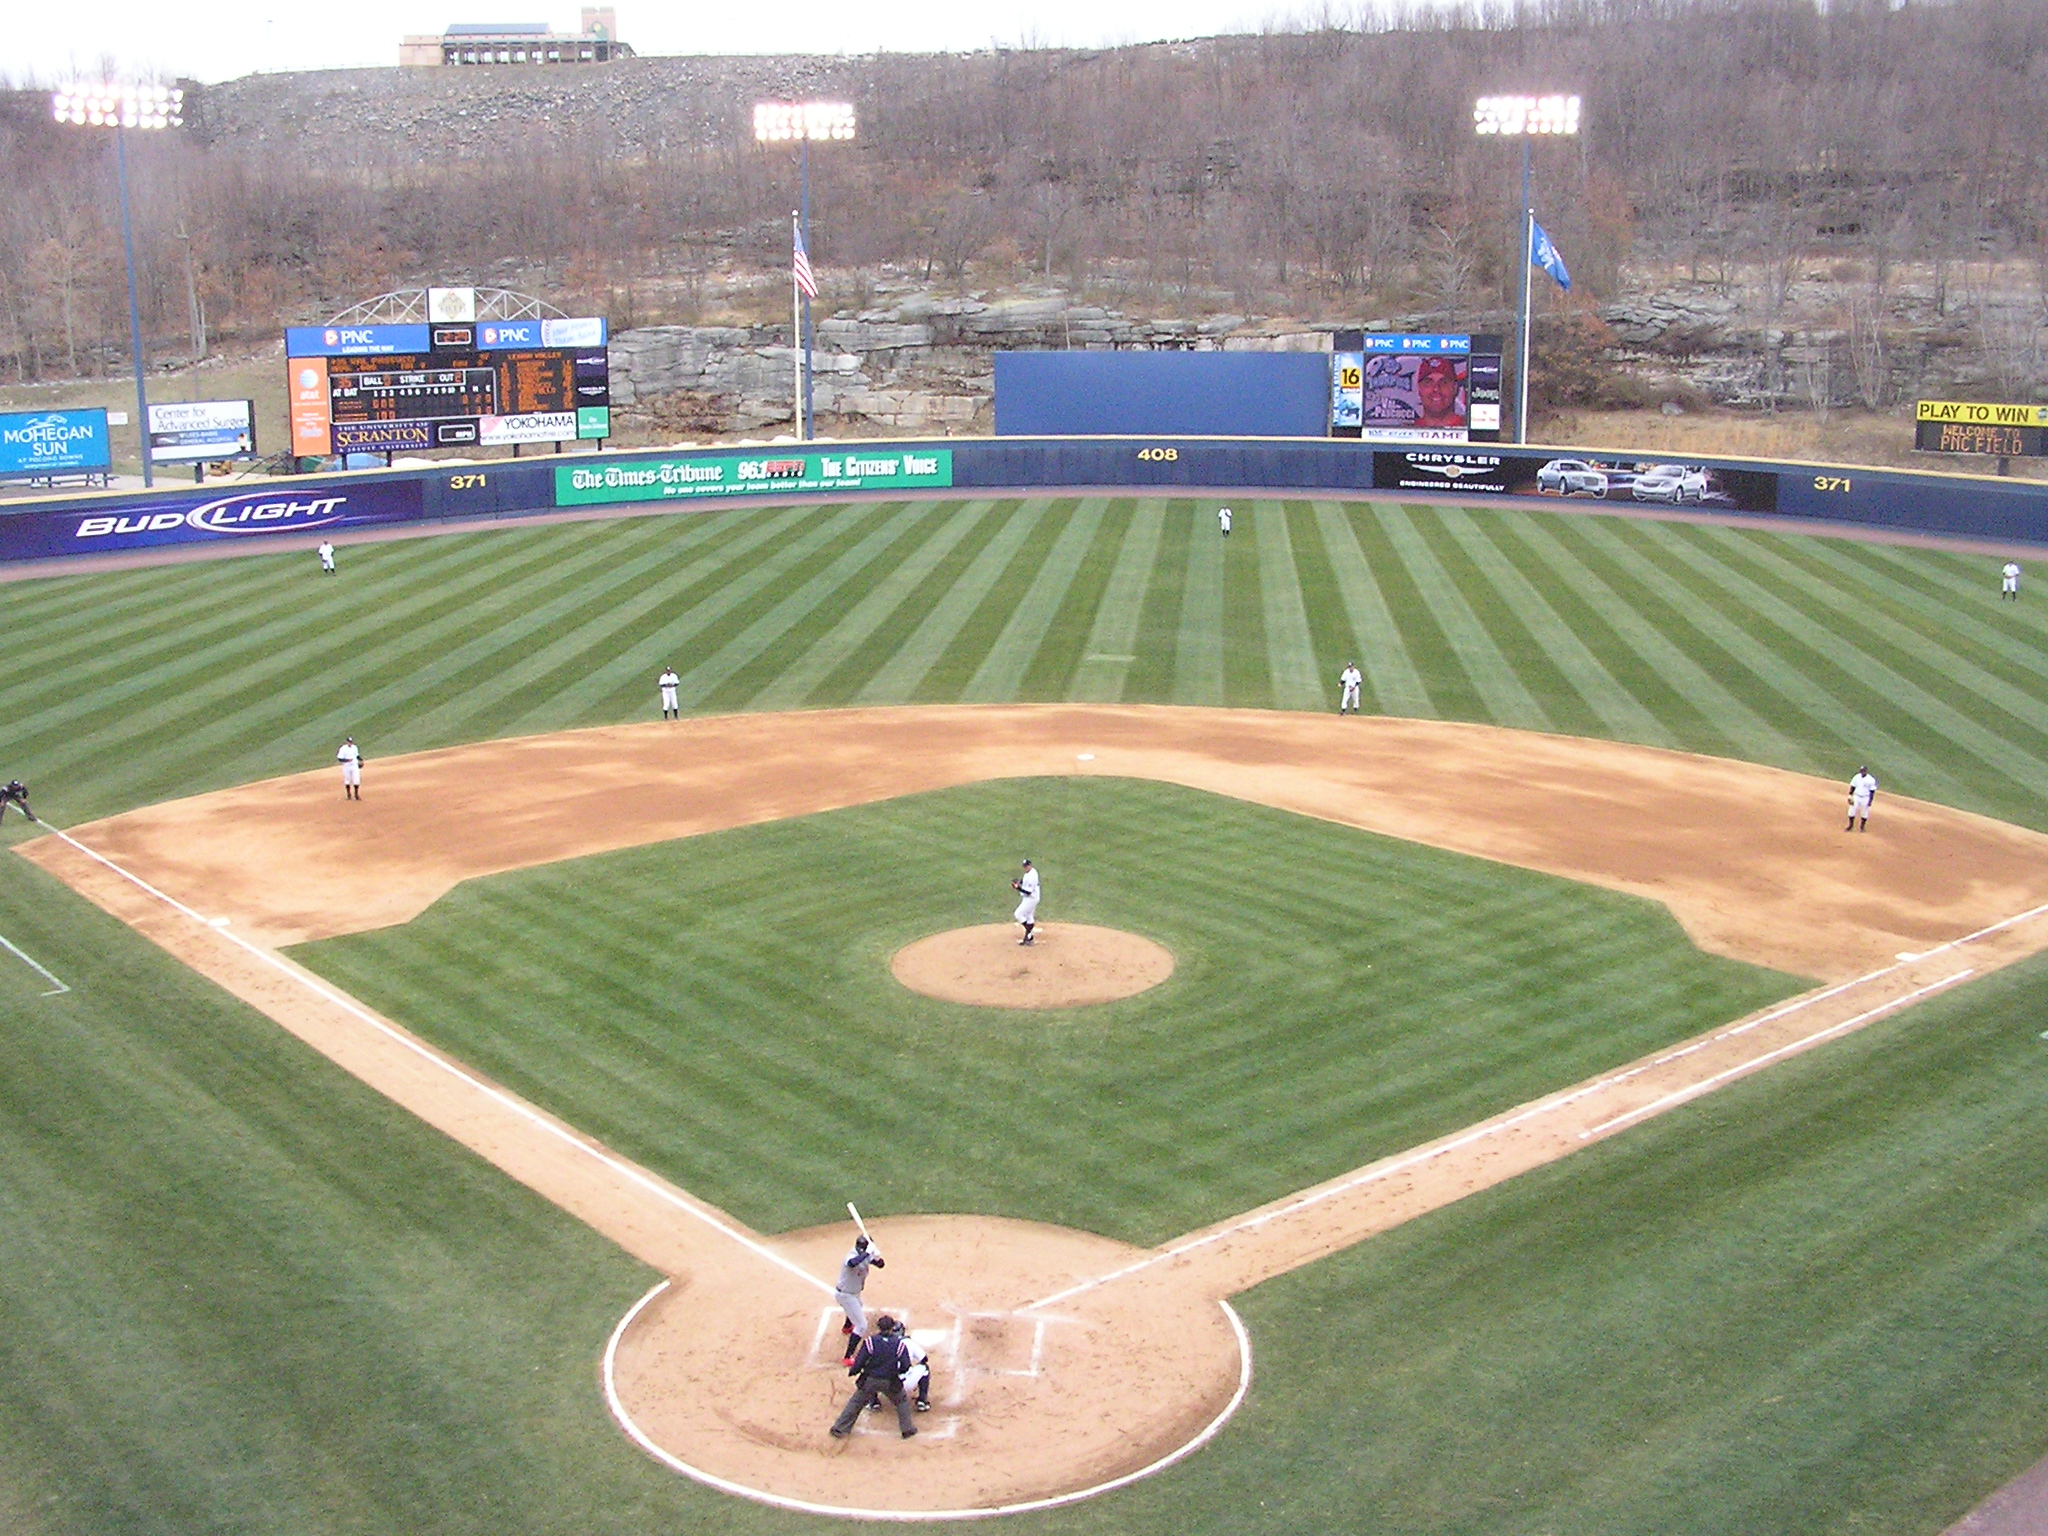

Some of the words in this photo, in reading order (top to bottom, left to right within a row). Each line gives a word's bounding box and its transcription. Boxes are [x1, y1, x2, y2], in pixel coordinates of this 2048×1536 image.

[341, 330, 373, 344] PNC
[499, 328, 530, 342] PNC
[1375, 339, 1393, 348] PNC
[1412, 340, 1431, 348] PNC
[1450, 340, 1469, 348] PNC
[364, 377, 384, 386] BALL
[400, 374, 425, 384] STRIKE
[439, 373, 454, 382] OUT
[1342, 368, 1360, 384] 16
[333, 388, 341, 397] AT
[344, 387, 358, 397] BAT
[389, 389, 395, 397] 3
[400, 388, 405, 396] 4
[426, 387, 431, 395] 7
[433, 387, 439, 395] 8
[448, 386, 456, 394] 10
[155, 408, 189, 420] Center
[192, 406, 207, 417] for
[1919, 404, 1960, 418] PLAY
[1966, 405, 1989, 420] TO
[1996, 407, 2029, 422] WIN
[158, 420, 210, 432] Advanced
[504, 416, 575, 430] YOKOHAMA
[4, 425, 94, 444] MOHEGAN
[337, 428, 429, 447] SCRANTON
[1420, 431, 1463, 440] GAME
[1943, 424, 1998, 438] WELCOME
[2003, 427, 2020, 438] TO
[33, 441, 68, 456] SUN
[1940, 436, 1970, 452] PNC
[1976, 437, 2022, 455] FIELD
[1137, 448, 1178, 461] 408
[1406, 453, 1500, 465] CHRYSLER
[451, 474, 486, 489] 371
[572, 469, 603, 489] The
[605, 463, 723, 488] Times-Tribune
[663, 486, 676, 495] No
[677, 486, 694, 494] one
[695, 485, 725, 493] covers
[726, 483, 746, 493] your
[747, 482, 769, 491] team
[771, 480, 797, 490] better
[799, 479, 819, 489] than
[820, 480, 836, 488] our
[837, 478, 862, 487] team!
[1400, 480, 1451, 488] ENGINEERED
[1452, 482, 1505, 491] BEAUTIFULLY
[1813, 476, 1850, 493] 371
[76, 514, 185, 537] BUD
[210, 498, 346, 524] LIGHT
